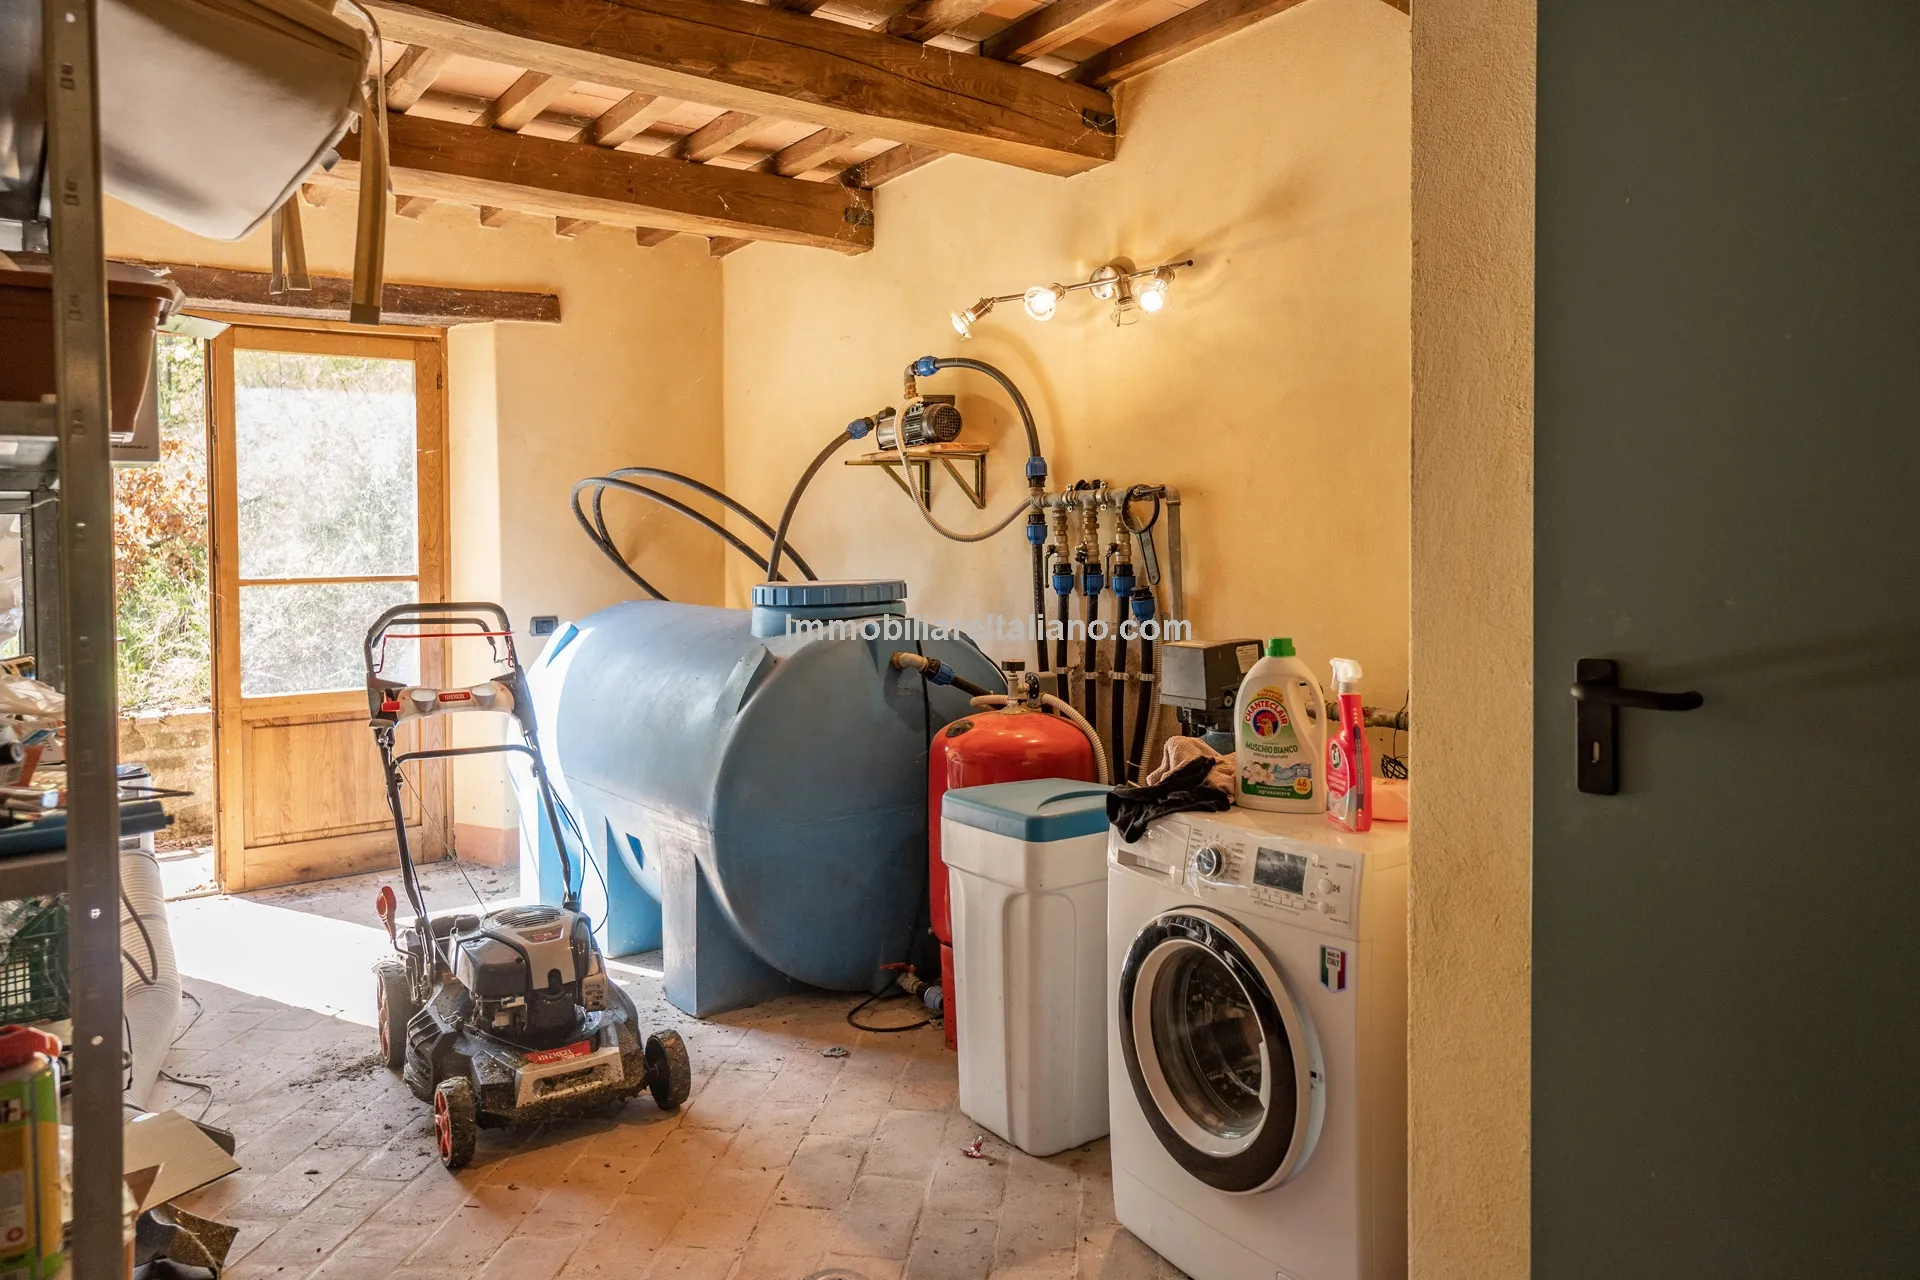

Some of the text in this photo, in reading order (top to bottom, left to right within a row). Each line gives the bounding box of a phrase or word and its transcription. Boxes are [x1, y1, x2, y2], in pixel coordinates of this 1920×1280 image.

[1245, 700, 1288, 725] CHANTECLAIR
[1245, 741, 1299, 754] MUSCHIO BIANCO
[1297, 778, 1307, 787] 46
[1327, 957, 1339, 966] ITALY
